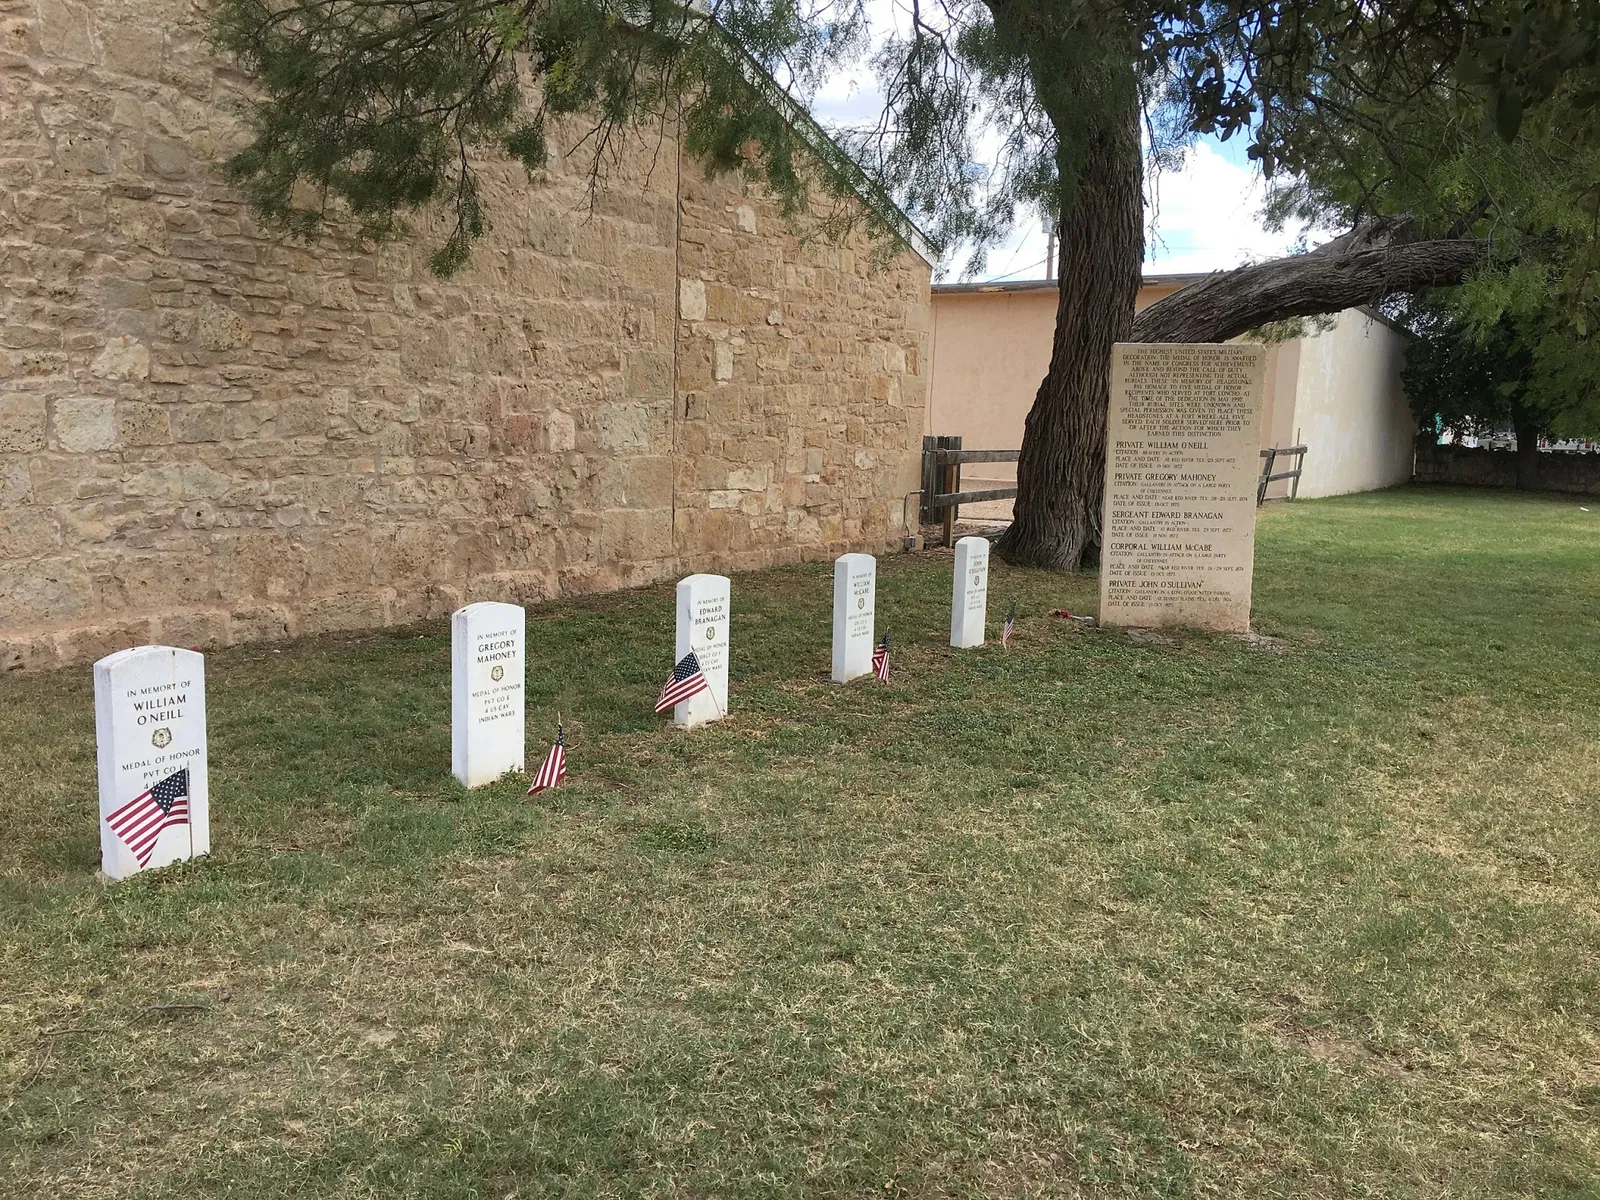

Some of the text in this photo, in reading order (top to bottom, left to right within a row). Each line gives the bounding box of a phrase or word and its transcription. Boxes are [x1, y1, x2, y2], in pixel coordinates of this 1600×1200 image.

[700, 606, 722, 615] EDWARD
[695, 614, 726, 625] BRANAGAN
[486, 631, 508, 639] MEMORY
[478, 640, 515, 652] GREGORY
[477, 650, 516, 663] MAHONEY
[141, 684, 176, 695] MEMORY
[472, 690, 490, 698] MEDAL
[501, 683, 521, 691] HONOR
[134, 694, 186, 711] WILLIAM
[137, 709, 183, 725] O'NEILL
[479, 714, 498, 723] INDIAN
[122, 749, 200, 771] MEDAL OF HONOR
[144, 770, 160, 779] PVT
[164, 766, 176, 775] CO
